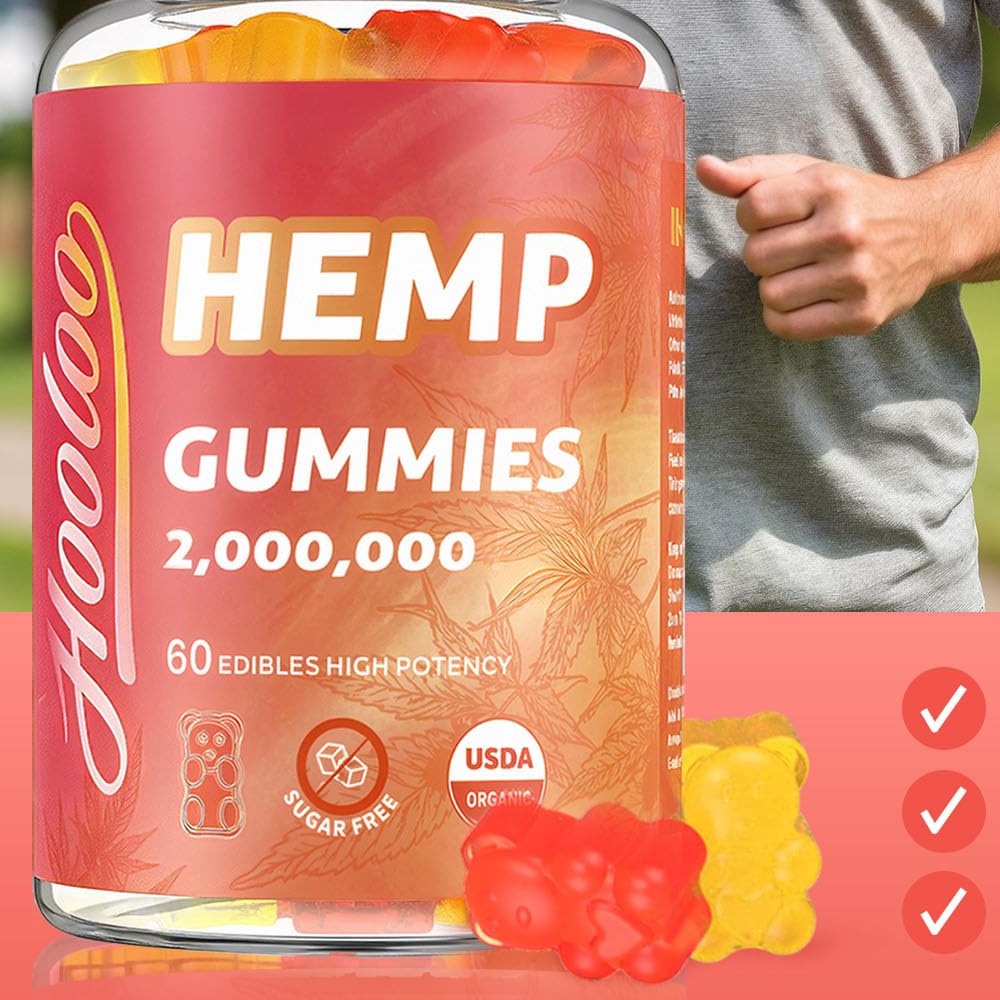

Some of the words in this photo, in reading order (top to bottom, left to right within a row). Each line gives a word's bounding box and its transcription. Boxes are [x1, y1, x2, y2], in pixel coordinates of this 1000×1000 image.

[170, 230, 595, 343] HEMP
[163, 426, 582, 493] GUMMIES
[42, 201, 137, 796] Hooloo
[163, 529, 476, 577] 2,000,000
[167, 638, 213, 676] 60
[218, 655, 320, 676] EDIBLES
[327, 656, 389, 676] HIGH
[396, 656, 512, 676] POTENCY
[465, 746, 533, 770] USDA
[283, 789, 347, 838] SUGAR
[351, 792, 399, 836] FREE
